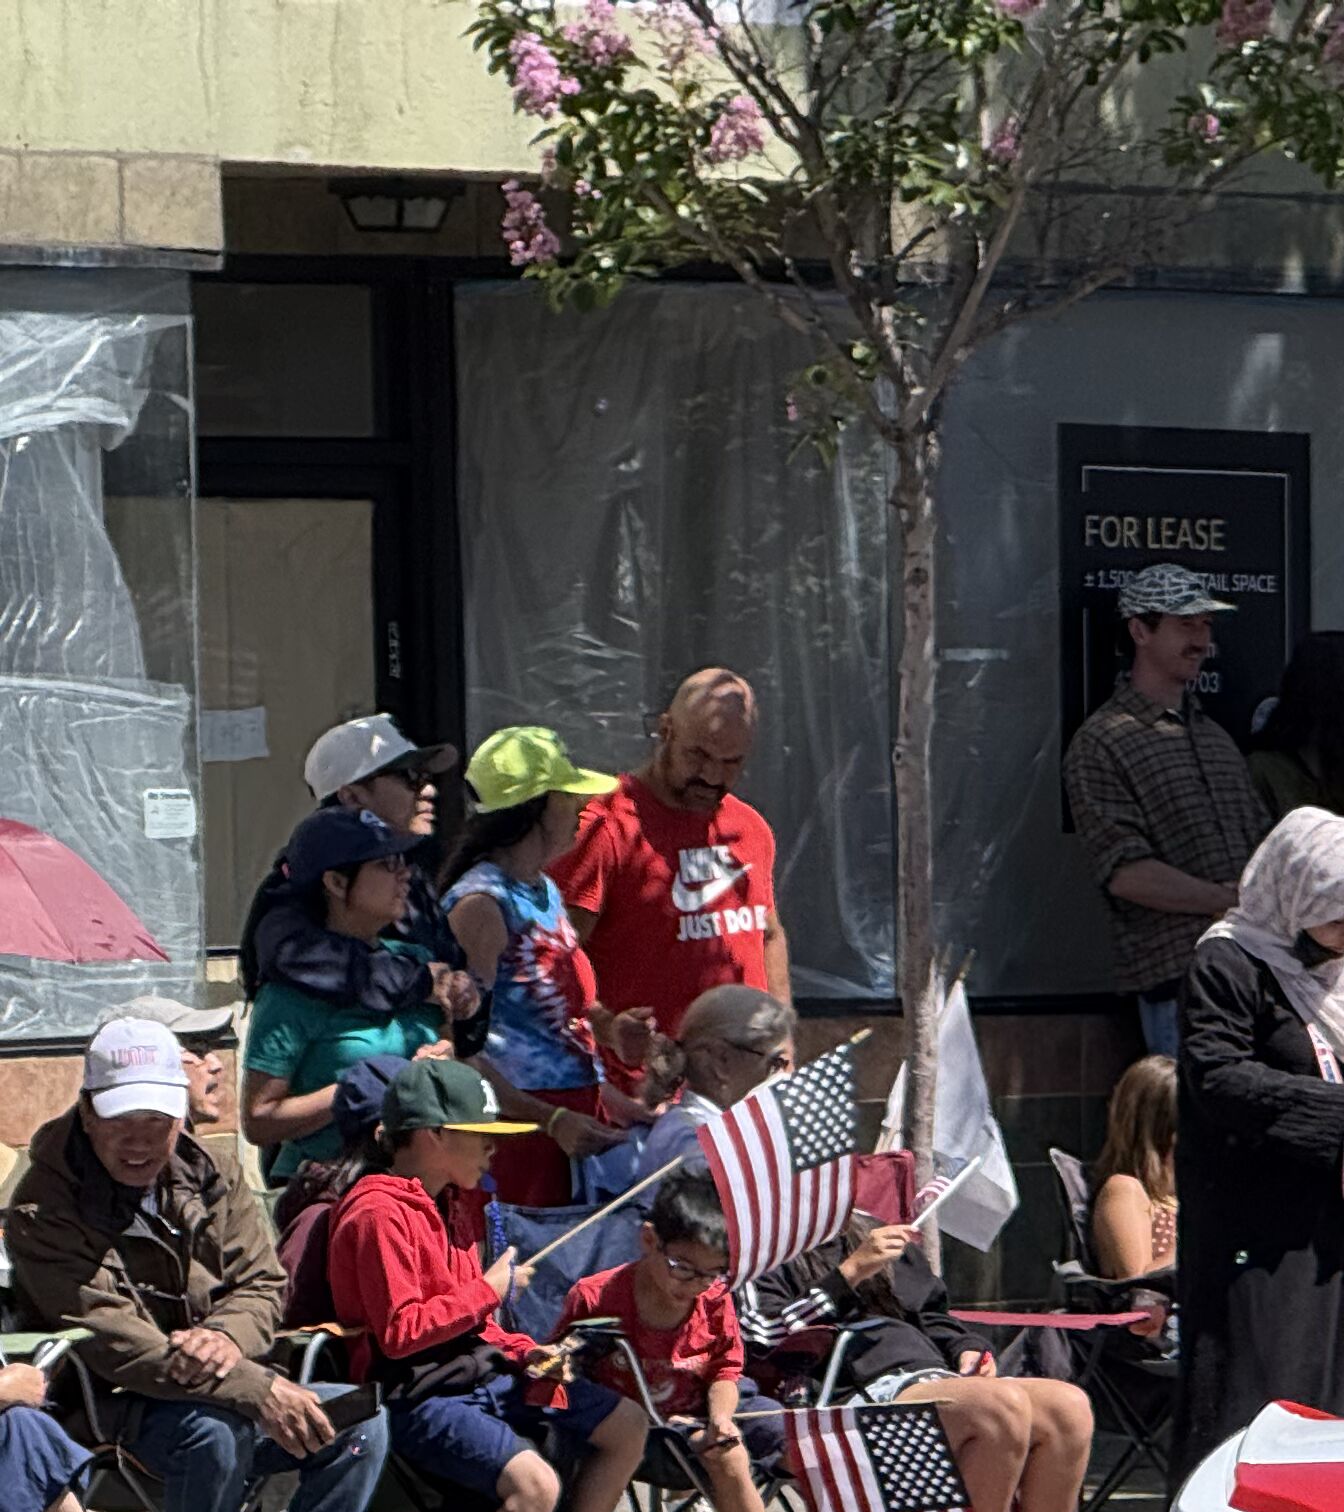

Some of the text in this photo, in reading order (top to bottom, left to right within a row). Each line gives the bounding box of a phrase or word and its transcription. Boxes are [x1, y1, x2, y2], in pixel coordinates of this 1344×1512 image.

[1085, 515, 1226, 551] FOR LEASE
[1231, 574, 1280, 593] SPACE
[677, 910, 722, 942] JUST
[723, 905, 753, 934] DO
